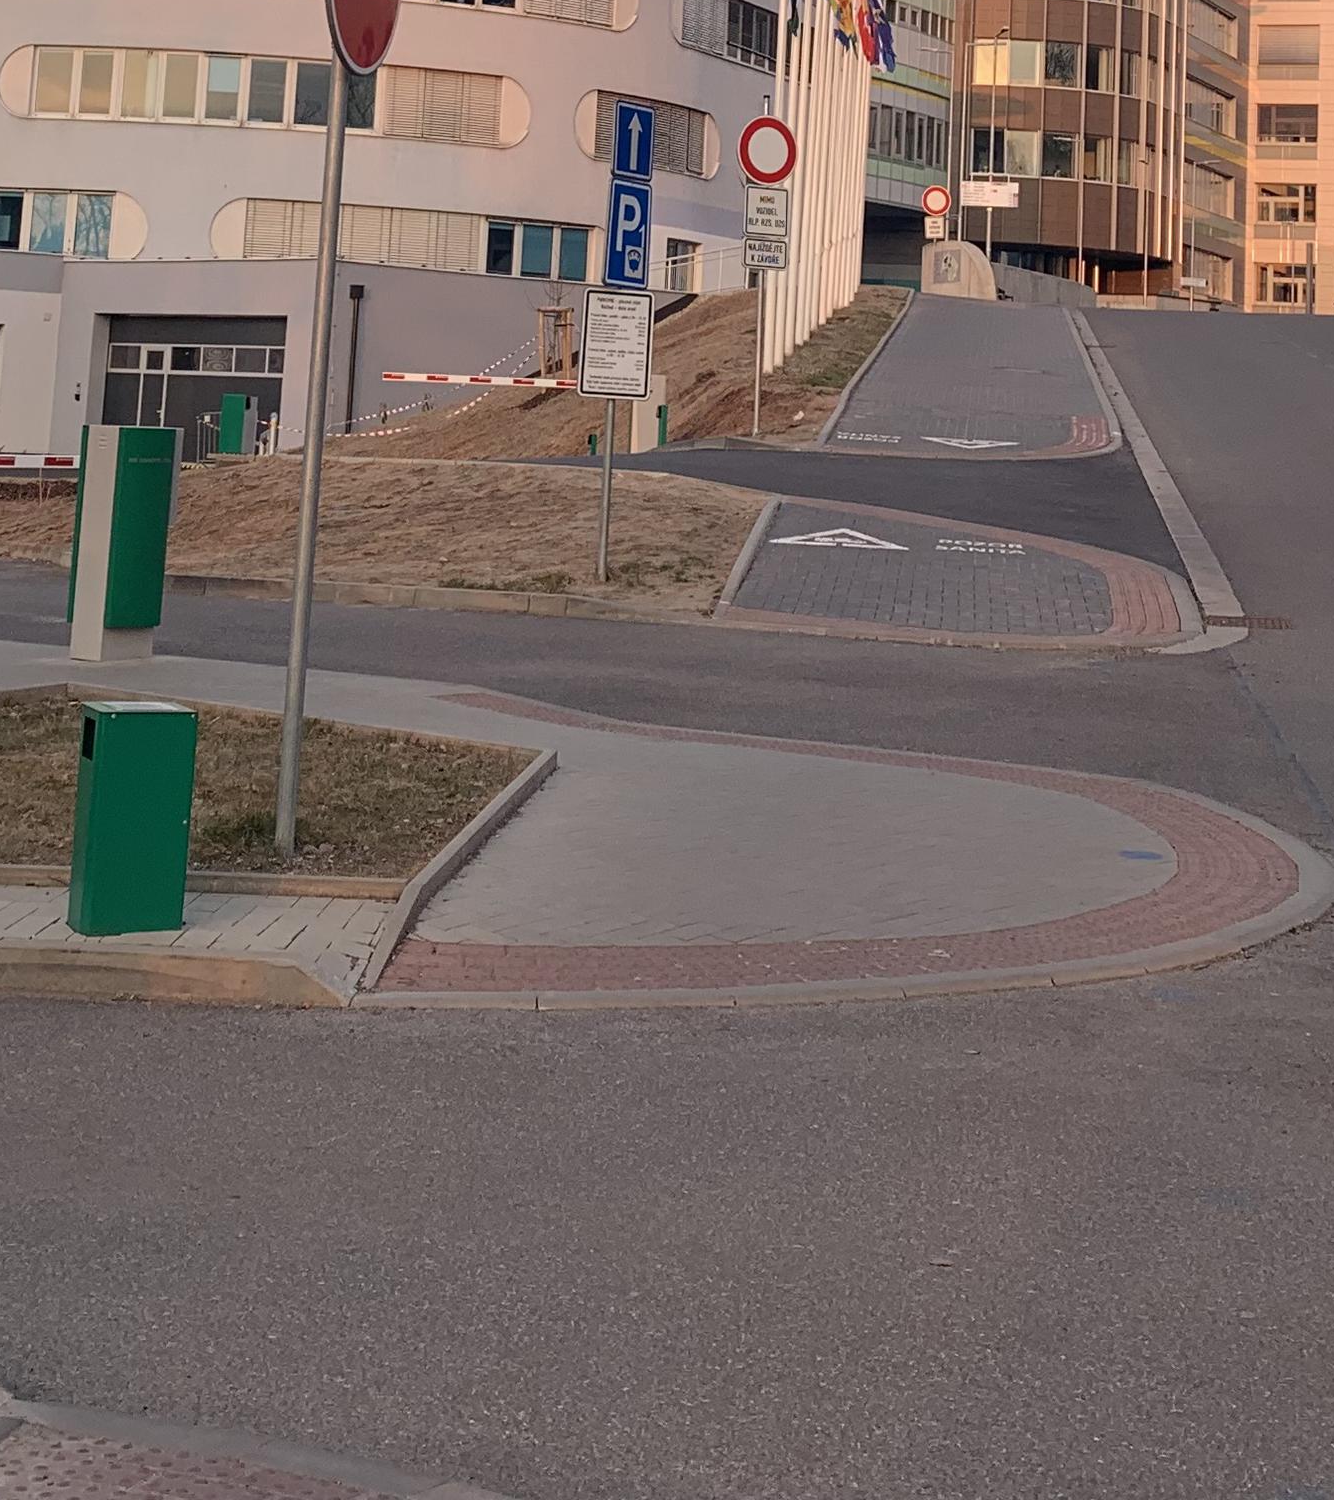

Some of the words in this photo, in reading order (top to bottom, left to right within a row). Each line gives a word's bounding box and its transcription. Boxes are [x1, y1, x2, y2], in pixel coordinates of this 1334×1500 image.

[759, 196, 775, 204] MIMO
[615, 193, 642, 252] P
[938, 539, 1023, 549] POZOR
